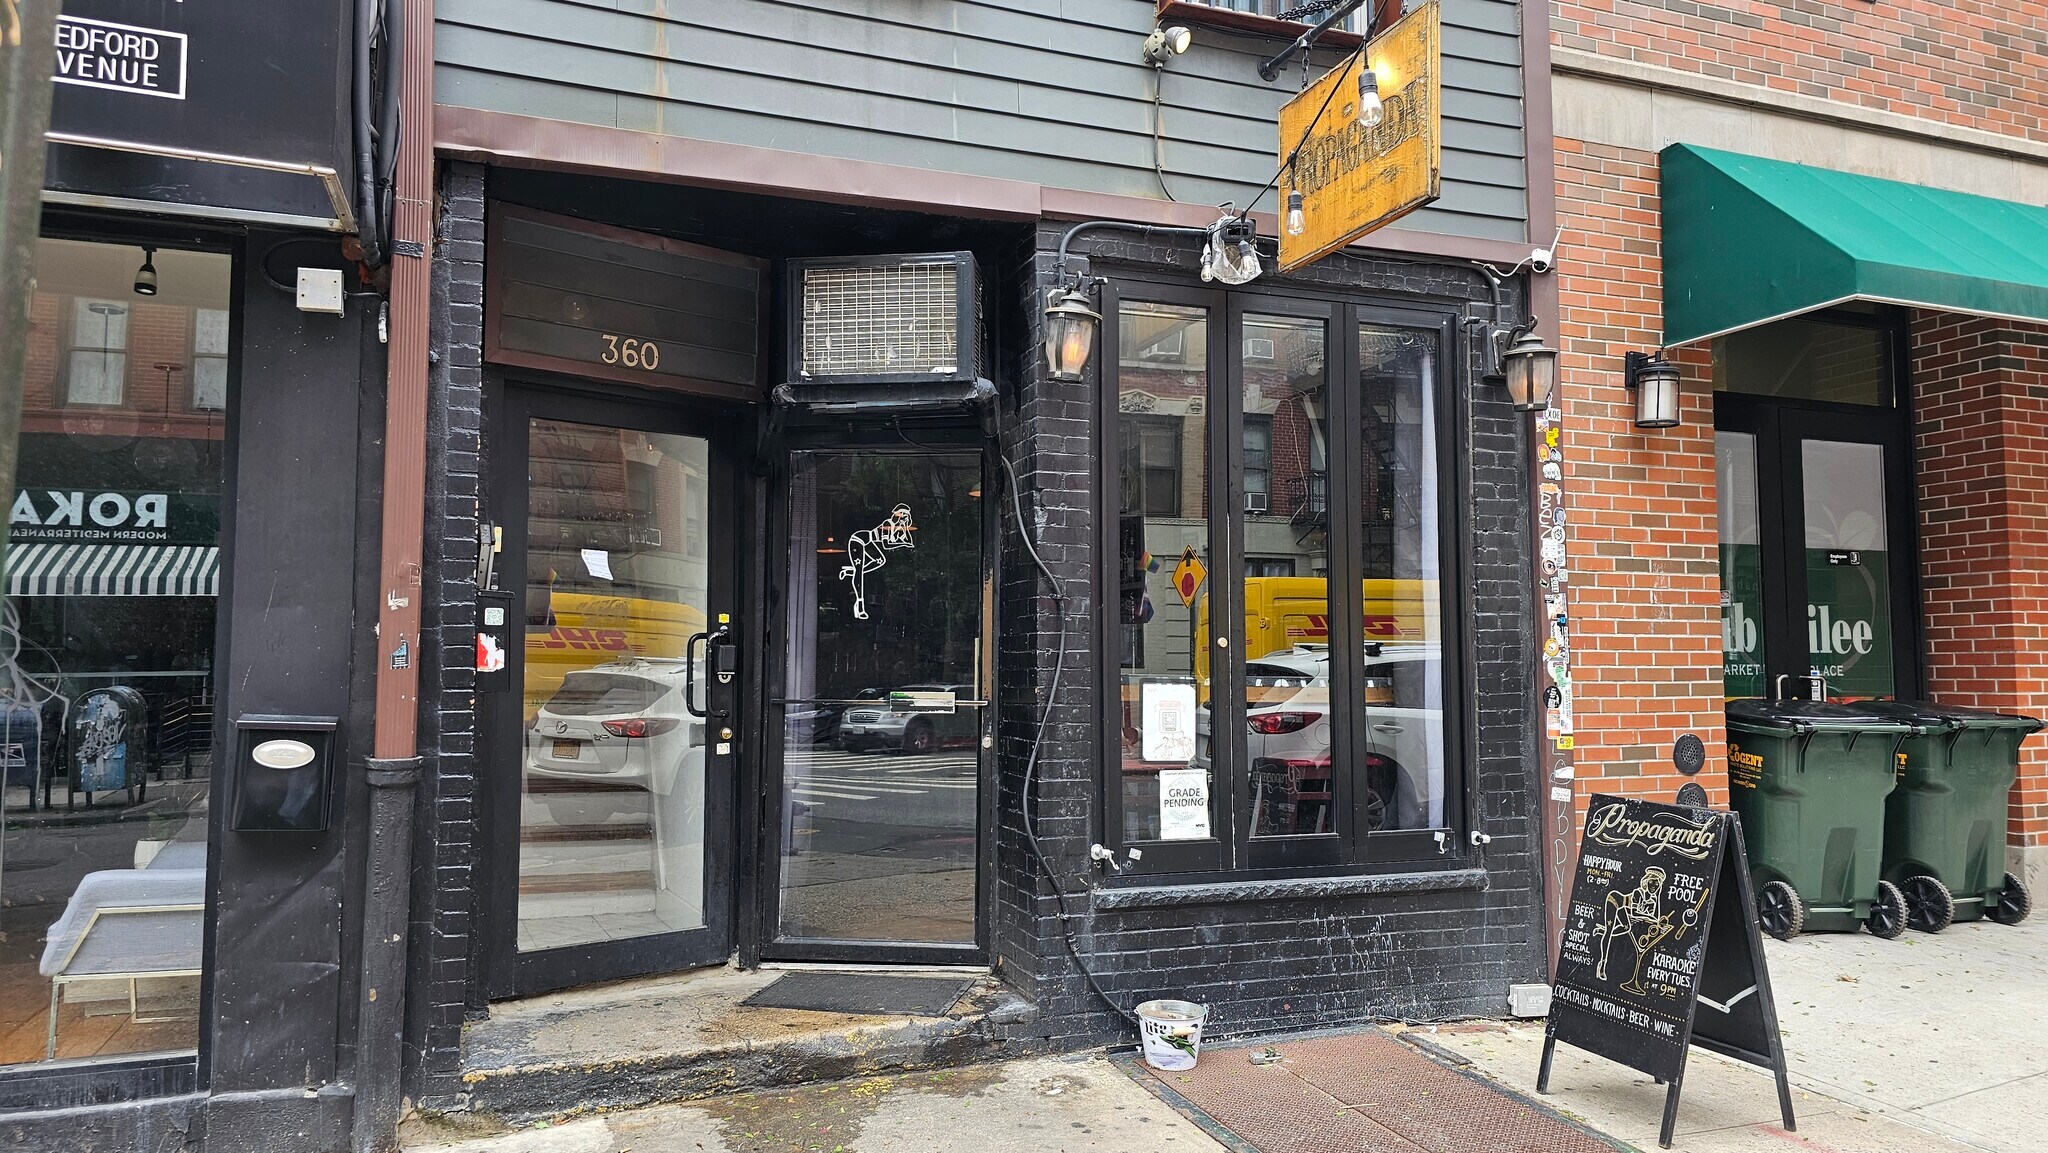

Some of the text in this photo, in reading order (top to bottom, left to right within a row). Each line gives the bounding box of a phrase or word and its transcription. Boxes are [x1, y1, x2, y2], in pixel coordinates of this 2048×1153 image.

[54, 23, 159, 61] EDFORD
[56, 49, 159, 88] VENUE
[601, 334, 659, 370] 360
[1724, 663, 1761, 676] ARKET
[1728, 743, 1764, 768] COGENT
[1168, 788, 1201, 798] GRADE
[1164, 798, 1204, 808] PENDING
[1587, 804, 1715, 855] Propaganda
[1583, 854, 1623, 872] HAPPY HOUR
[1674, 872, 1704, 890] FREE
[1667, 886, 1697, 904] POOL
[1574, 904, 1595, 920] BEER
[1577, 918, 1586, 929] &
[1568, 929, 1591, 945] SHOT
[1564, 941, 1591, 954] SPECIAL
[1563, 952, 1595, 966] ALWAYS!
[1652, 952, 1697, 975] KARAOKE
[1647, 966, 1692, 988] EVERY TUES.
[1554, 984, 1676, 1037] COCKTAILS MOCKTAILS BEER WINE
